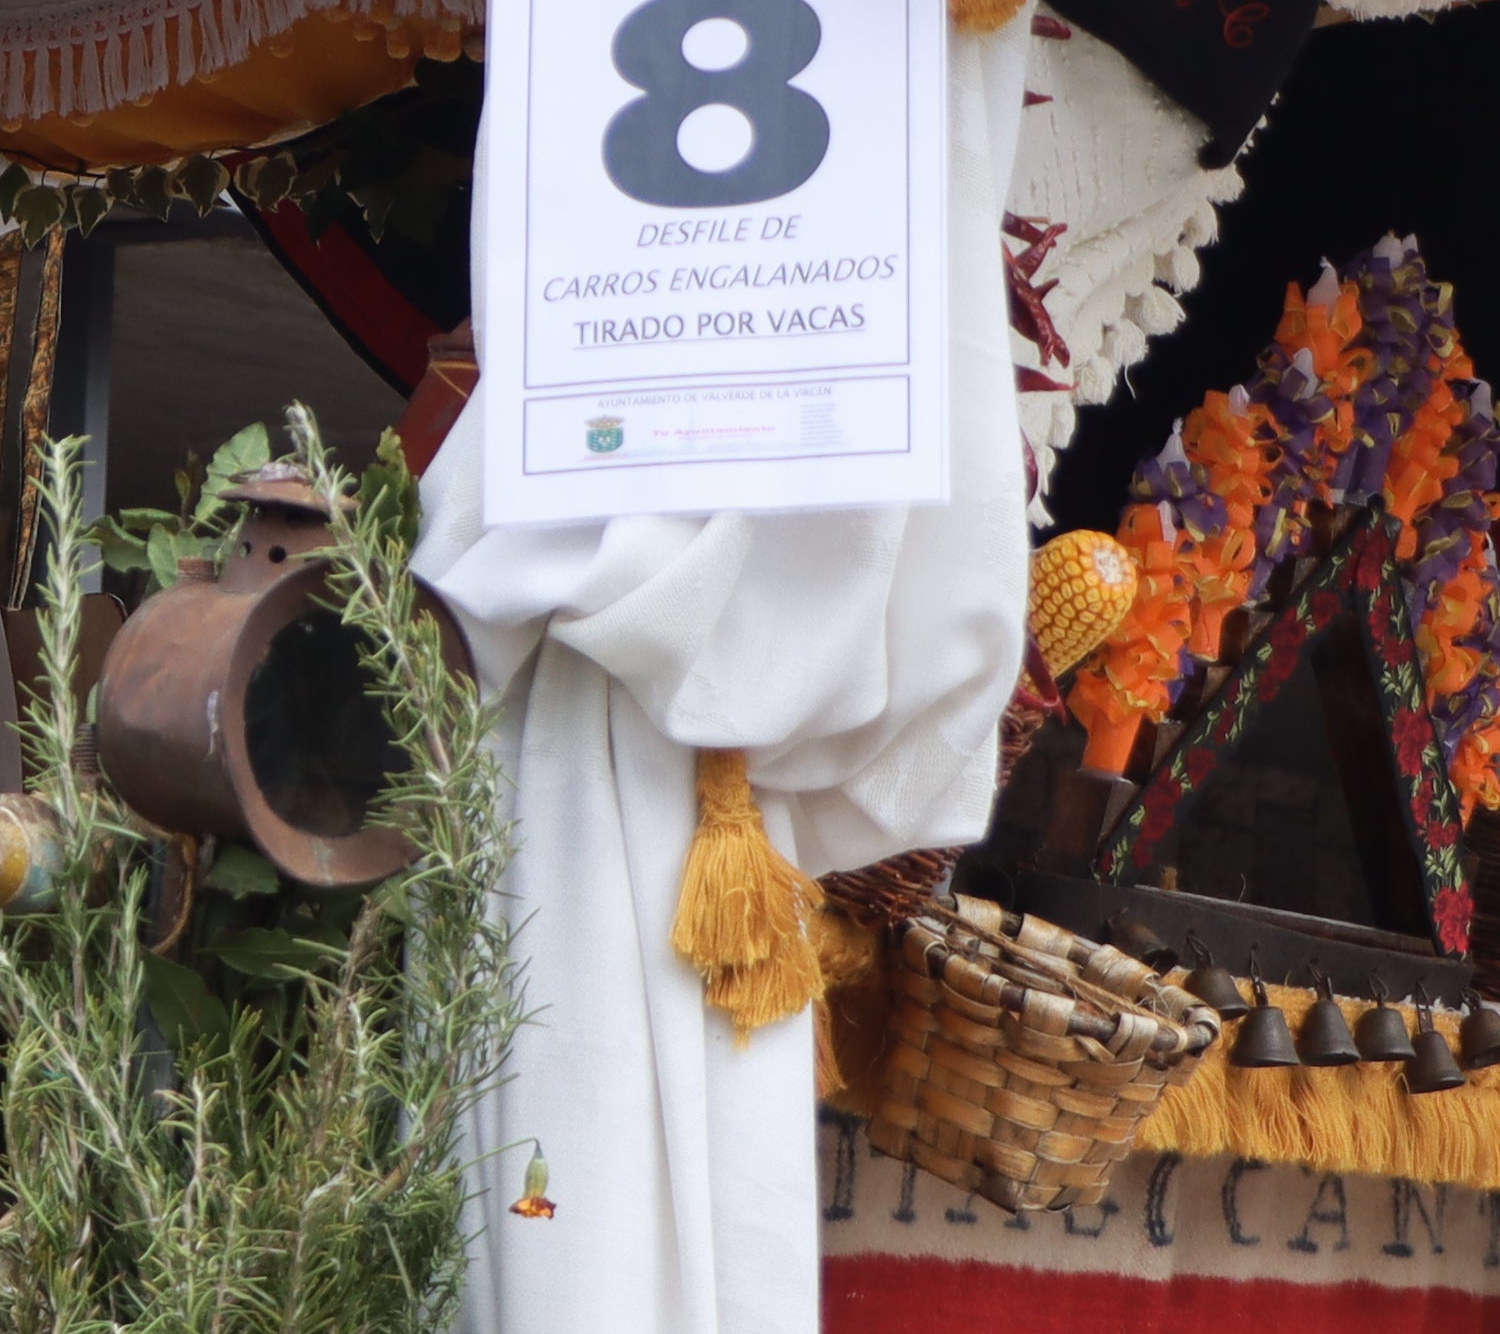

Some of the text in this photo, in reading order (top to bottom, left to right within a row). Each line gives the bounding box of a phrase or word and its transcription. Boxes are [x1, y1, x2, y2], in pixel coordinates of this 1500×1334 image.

[636, 214, 802, 247] DESFILE DE
[543, 254, 898, 303] CARROS ENGALANADOS
[573, 303, 866, 345] TIRADO POR VACAS
[597, 385, 833, 409] AYUNTAMIENTO DE VALVERDE DE LA VIRGEN
